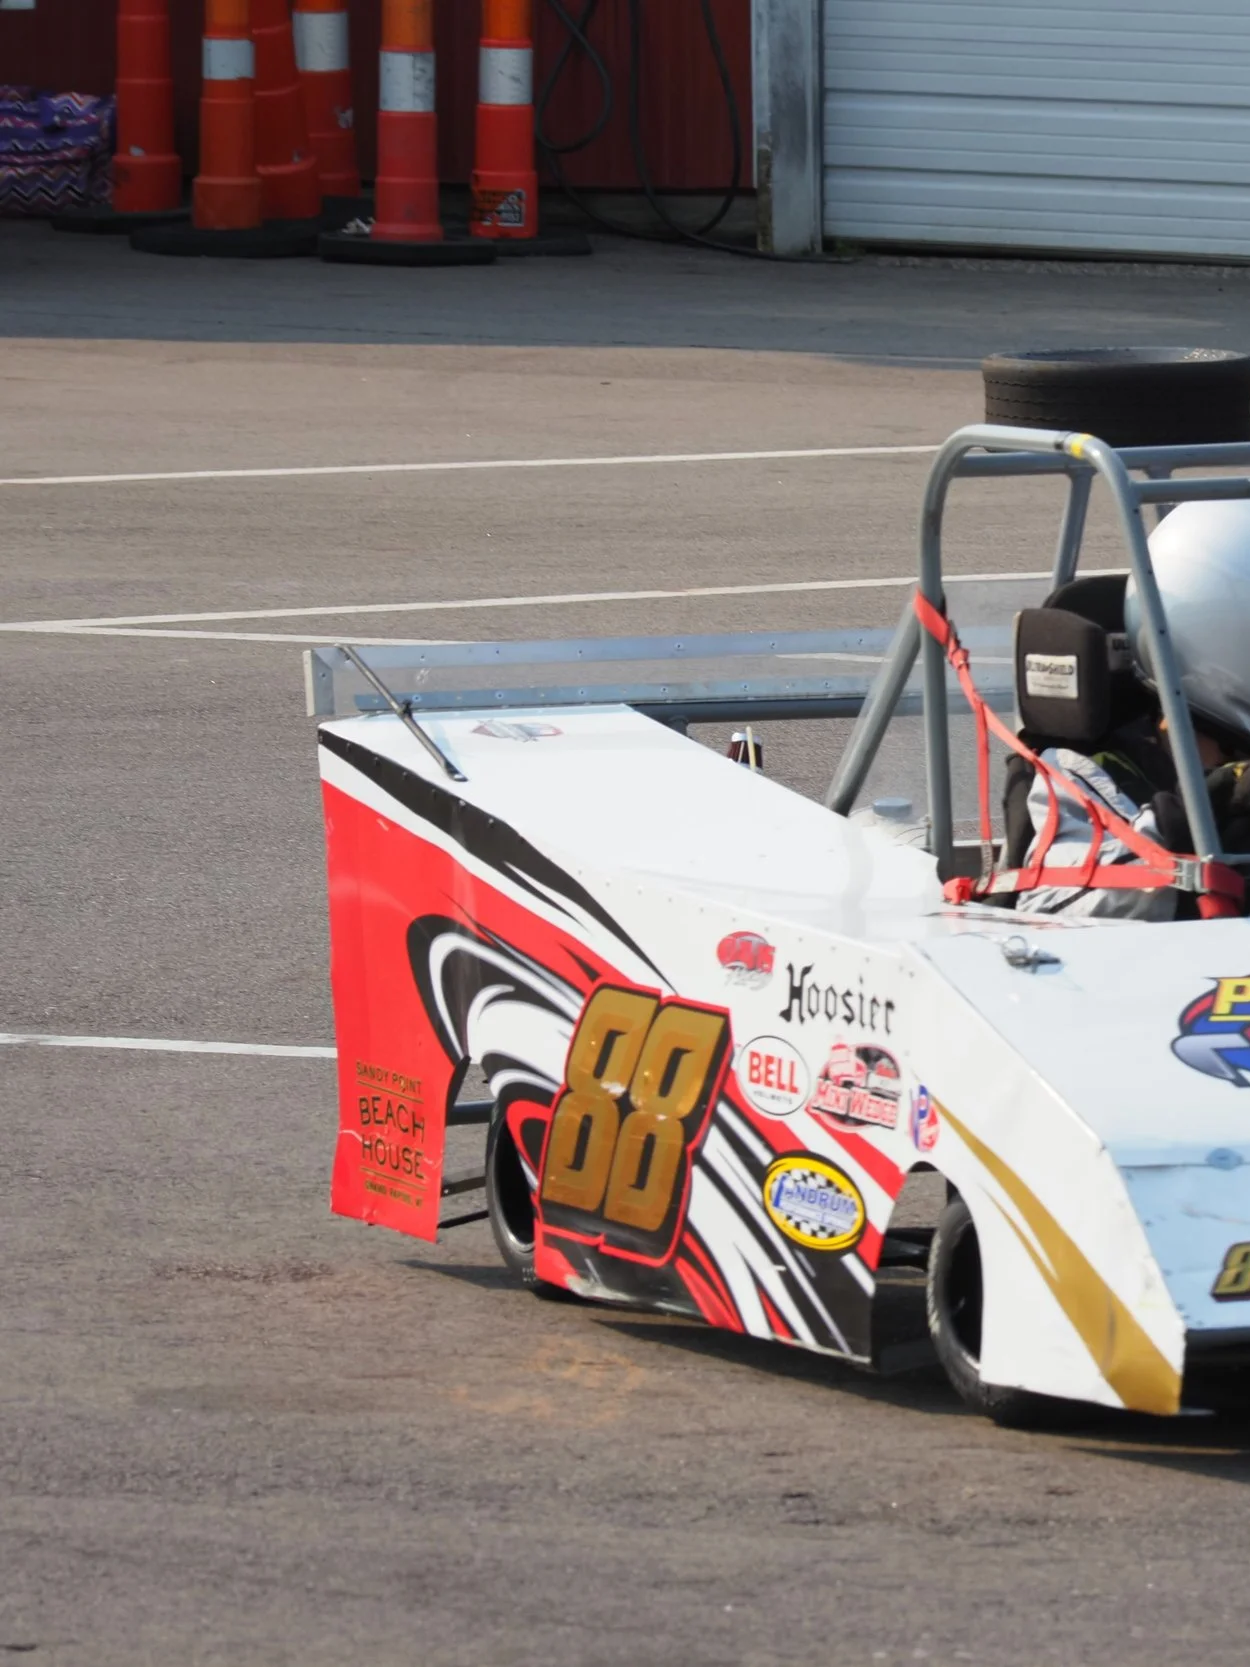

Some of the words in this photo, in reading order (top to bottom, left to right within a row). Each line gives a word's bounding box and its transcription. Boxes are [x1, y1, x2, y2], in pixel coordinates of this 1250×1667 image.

[778, 961, 896, 1036] Hoosier
[356, 1062, 390, 1083] SANDY
[391, 1071, 423, 1095] POINT
[749, 1050, 800, 1094] BELL
[358, 1096, 425, 1143] BEACH
[541, 986, 728, 1232] 88
[361, 1134, 425, 1180] HOUSE
